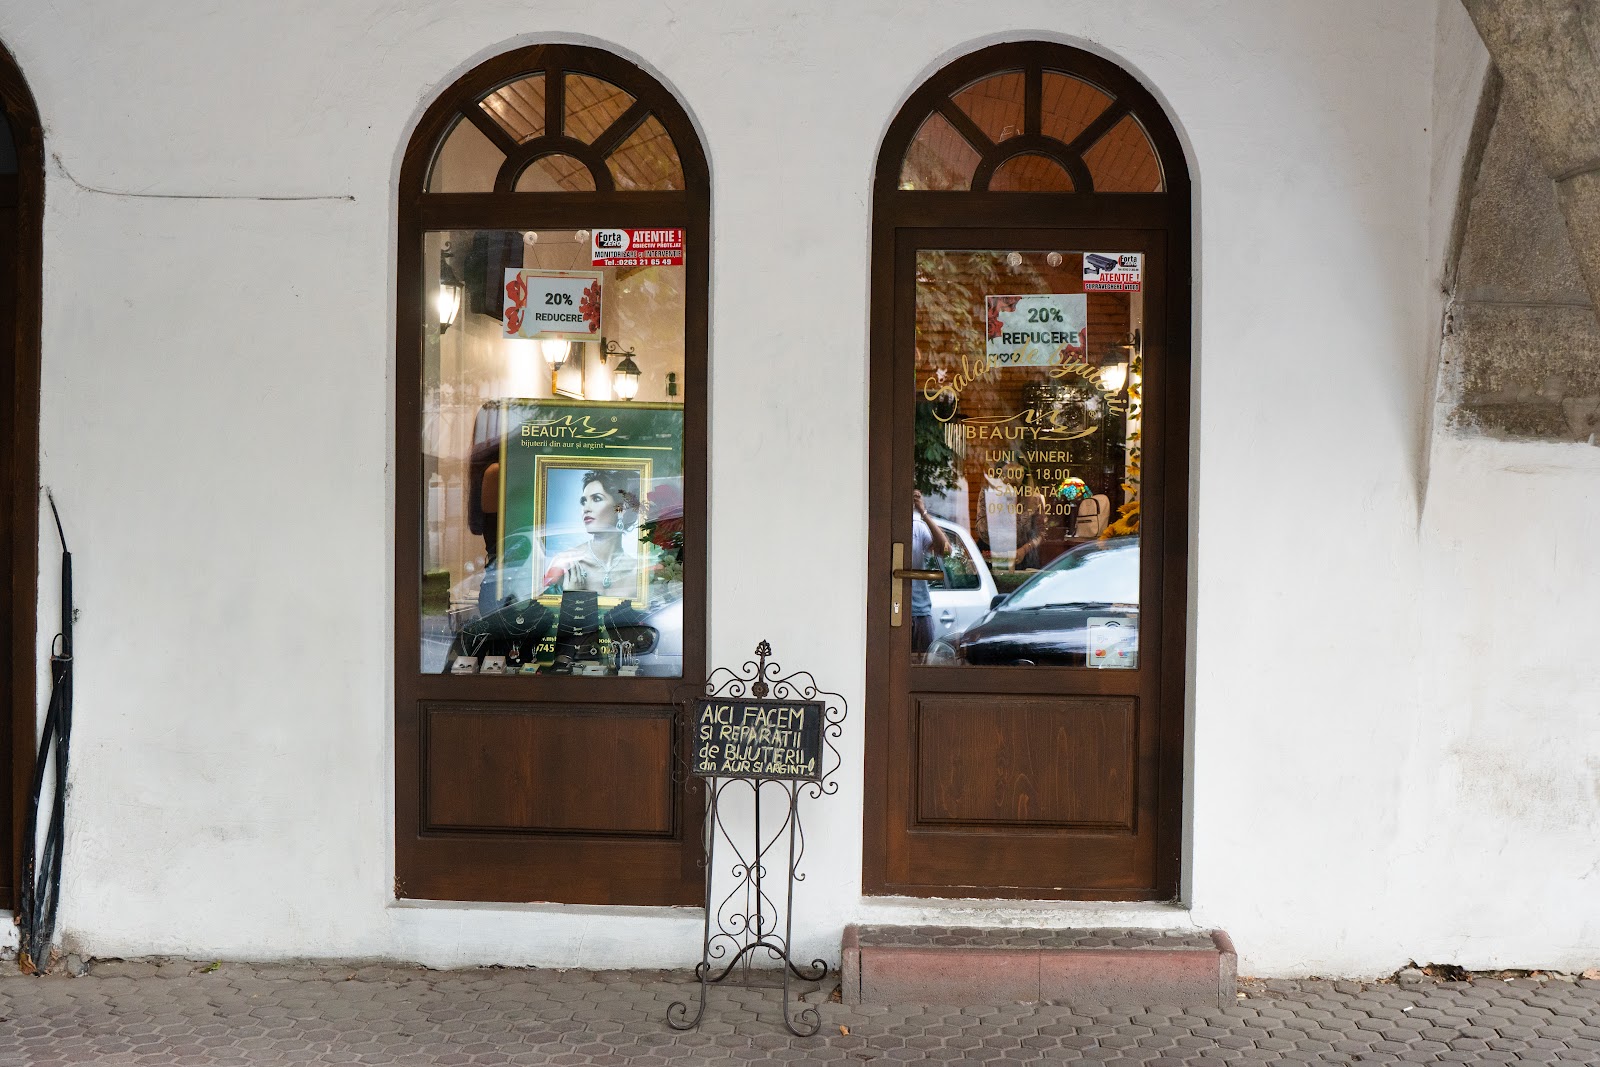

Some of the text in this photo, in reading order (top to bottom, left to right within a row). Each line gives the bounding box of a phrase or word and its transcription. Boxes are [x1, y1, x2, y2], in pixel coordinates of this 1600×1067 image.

[598, 231, 622, 242] Forta
[594, 250, 637, 258] MONITORIZARE
[545, 292, 573, 306] 20%
[535, 312, 583, 323] REDUCERE
[1027, 307, 1064, 323] 20%
[1002, 331, 1078, 345] REDUCERE
[924, 354, 1001, 422] Salon
[1012, 337, 1039, 366] de
[521, 425, 578, 438] BEAUTY
[966, 425, 1041, 440] BEAUTY
[521, 439, 548, 448] bijuterii
[549, 440, 561, 448] din
[582, 441, 604, 451] argint
[985, 450, 1015, 462] LUNI
[1027, 450, 1073, 463] VINERI:
[987, 467, 1023, 480] 09.00
[1036, 468, 1070, 480] 18.00
[1038, 503, 1071, 516] 12.00
[700, 704, 805, 731] AICI FACEM
[699, 742, 805, 765] de BIJUTERII
[699, 758, 717, 771] din
[721, 760, 750, 773] AUR
